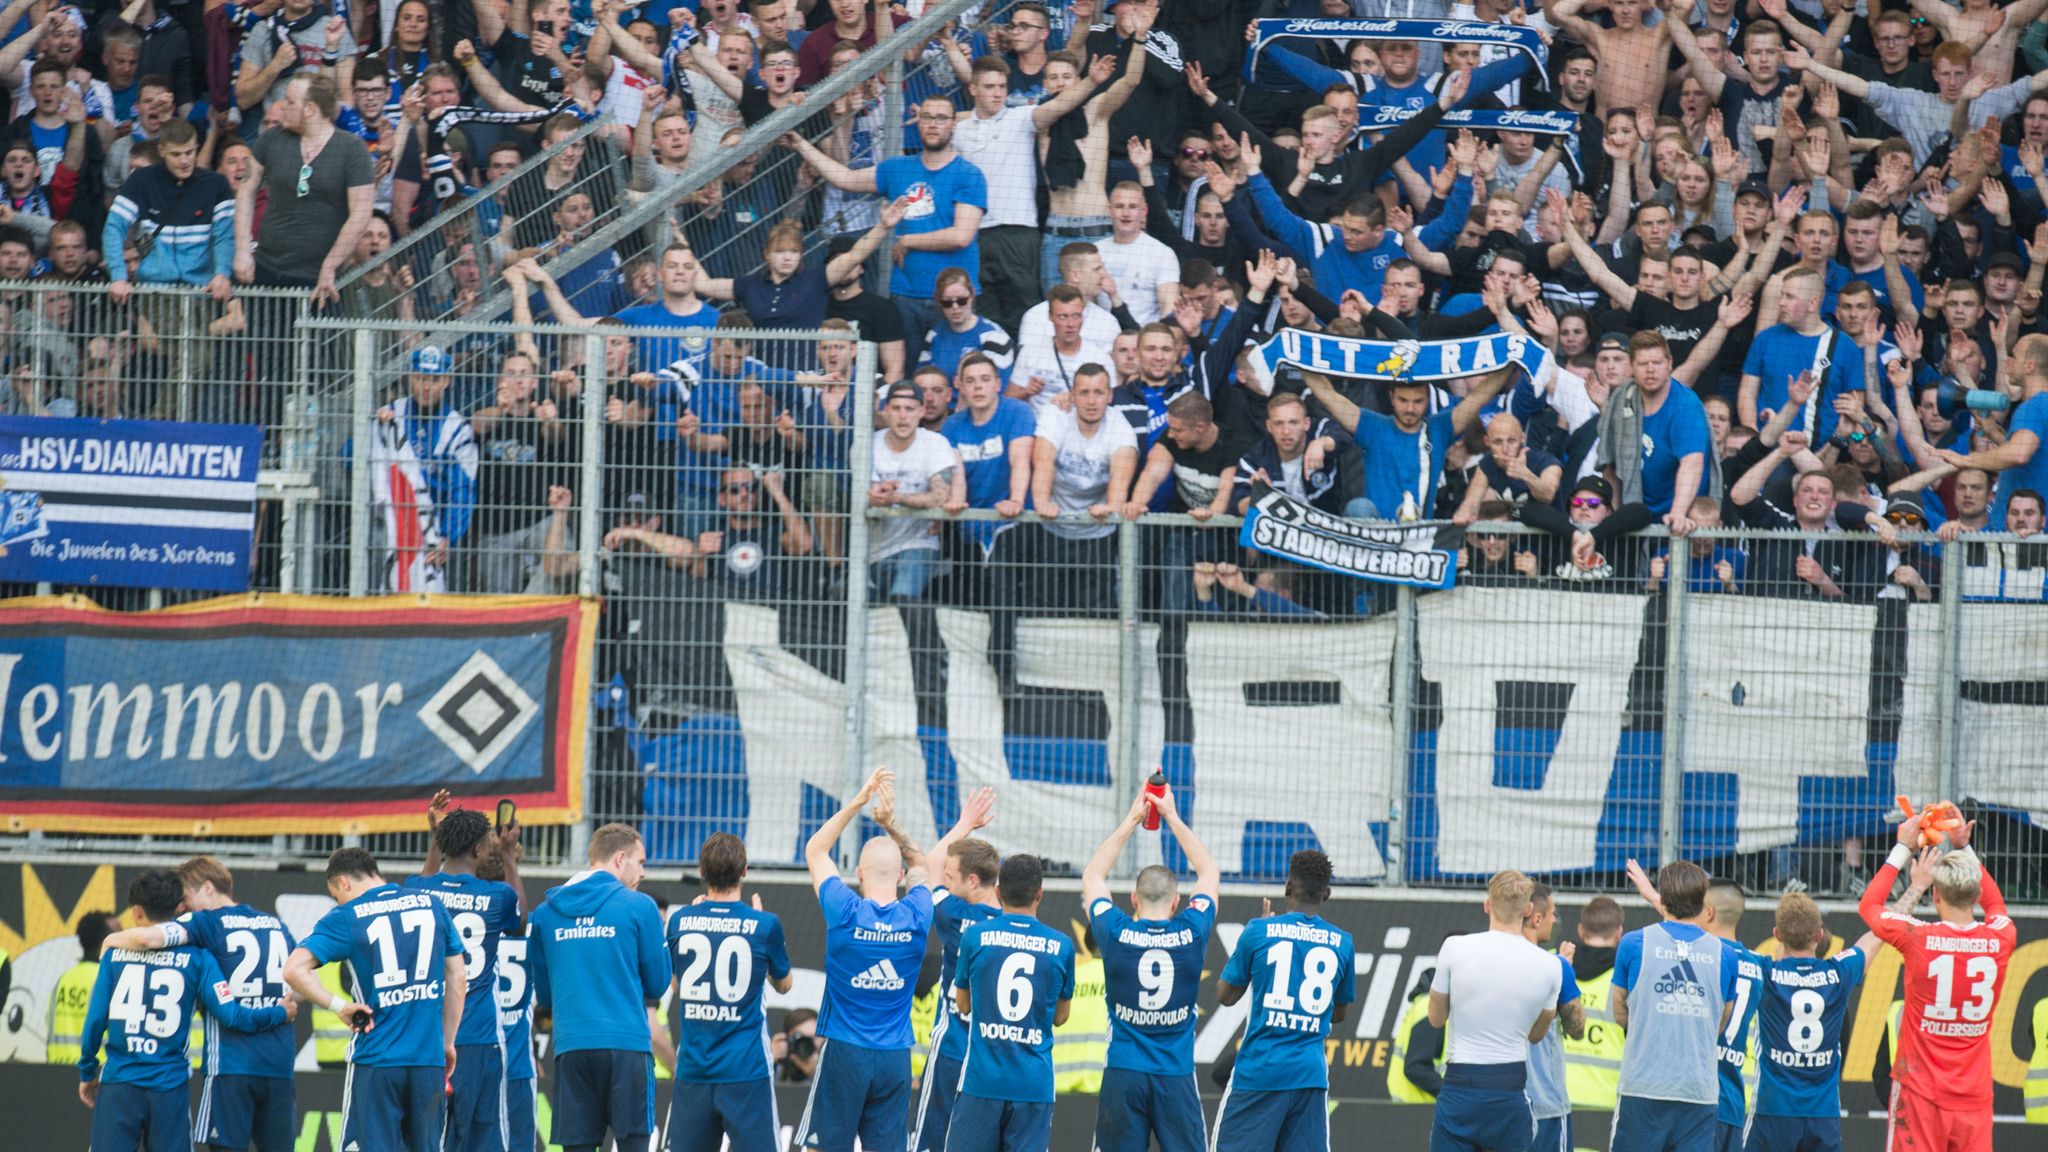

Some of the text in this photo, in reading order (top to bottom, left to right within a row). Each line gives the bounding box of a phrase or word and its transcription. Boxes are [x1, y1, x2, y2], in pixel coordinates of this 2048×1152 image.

[1286, 19, 1522, 41] Hansestadt Hamburg
[1497, 110, 1573, 131] Hamburg
[20, 436, 244, 479] HSV-DIAMANTEN
[30, 538, 236, 566] die Juwelen des Nordens
[1255, 515, 1447, 582] STADIONVERBOT
[354, 896, 417, 918] HAMBURGER
[475, 895, 491, 911] SV
[555, 925, 616, 942] Emirates
[679, 916, 758, 935] HAMBURGER SV
[854, 927, 912, 943] Emirates
[1266, 923, 1341, 948] HAMBURGER SV
[366, 909, 436, 989] 17
[981, 931, 1061, 956] HAMBURGER SV
[1119, 928, 1193, 948] HAMBURGER SV
[1925, 935, 1987, 953] HAMBURGER
[111, 949, 191, 968] HAMBURGER SV
[226, 929, 292, 997] 24
[678, 933, 752, 1002] 20
[851, 975, 905, 991] adidas
[996, 952, 1036, 1022] 6
[1137, 949, 1174, 1010] 9
[1263, 940, 1338, 1015] 18
[1654, 980, 1705, 997] adidas
[1923, 954, 1998, 1021] 13
[109, 963, 185, 1038] 43
[378, 980, 439, 1008] KOSTIĆ
[684, 1004, 741, 1021] EKDAL
[1115, 1003, 1188, 1026] PAPADOPOULOS
[1656, 1002, 1710, 1018] adidas
[1788, 989, 1825, 1053] 8
[1265, 1011, 1321, 1033] JATTA
[979, 1022, 1042, 1045] DOUGLAS
[127, 1036, 158, 1054] ITO
[1770, 1048, 1833, 1067] HOLTBY
